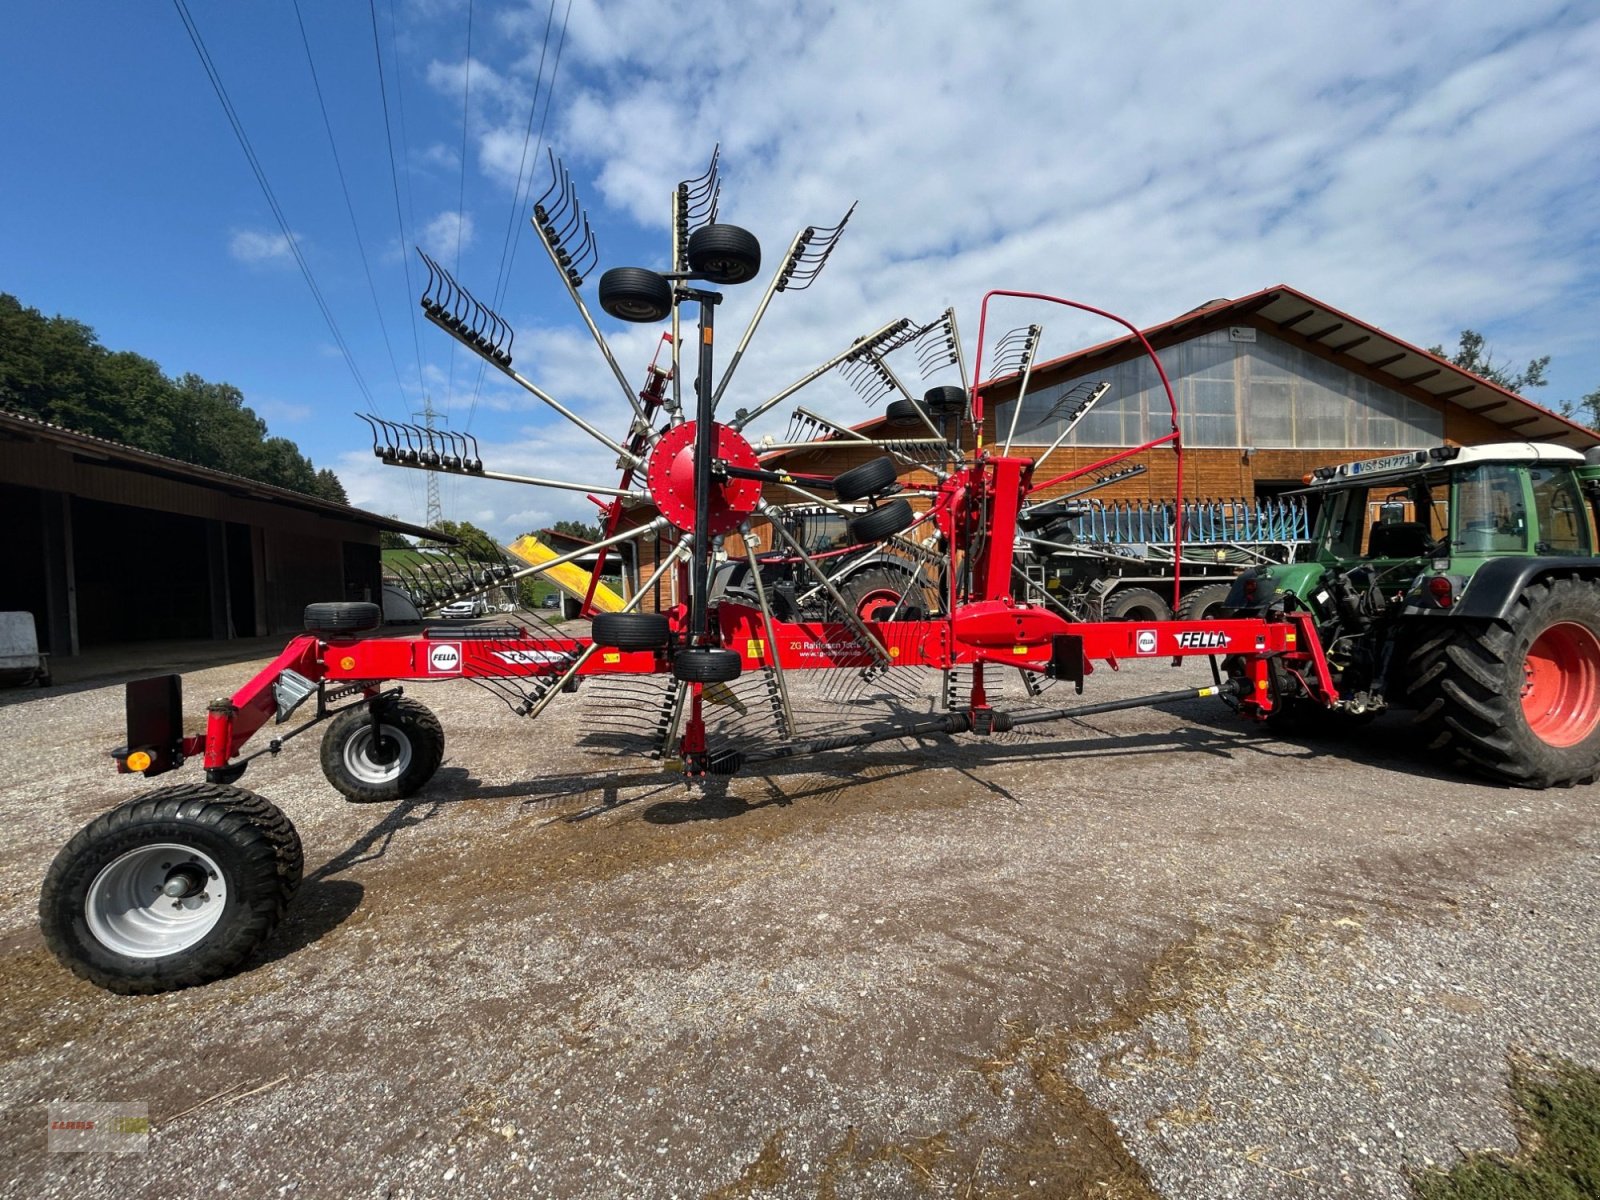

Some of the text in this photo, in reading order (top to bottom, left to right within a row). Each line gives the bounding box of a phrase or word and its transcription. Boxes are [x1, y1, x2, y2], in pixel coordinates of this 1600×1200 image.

[1378, 459, 1391, 469] SH
[1392, 455, 1411, 466] 771
[790, 641, 802, 650] ZG
[1180, 632, 1227, 648] FELLA
[433, 653, 457, 661] FELLA
